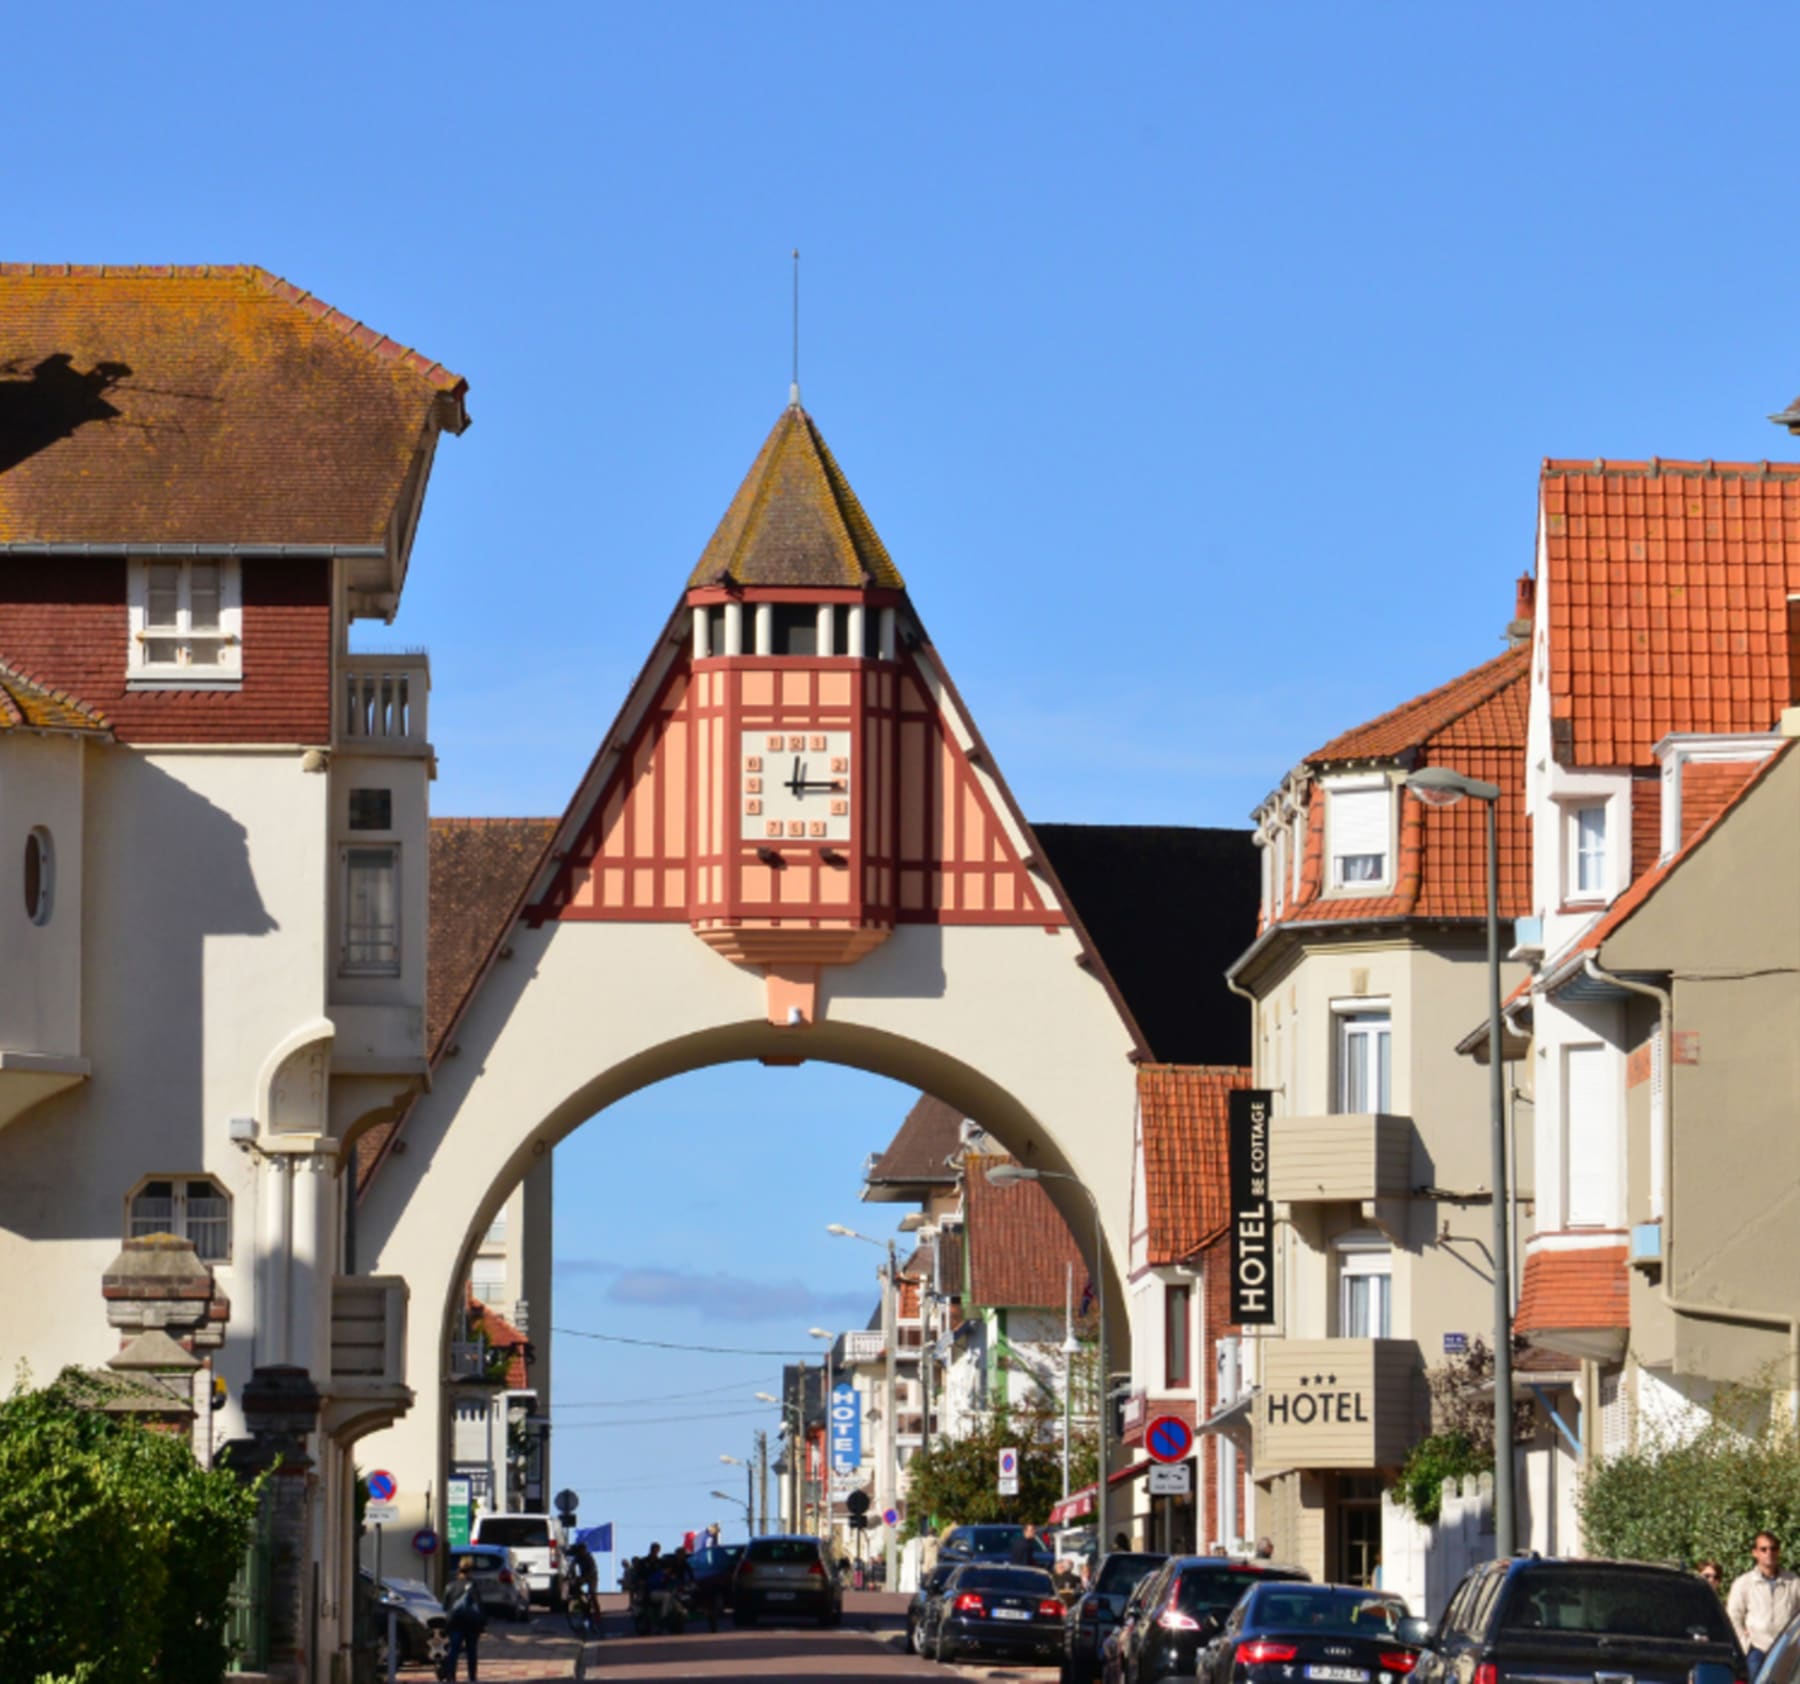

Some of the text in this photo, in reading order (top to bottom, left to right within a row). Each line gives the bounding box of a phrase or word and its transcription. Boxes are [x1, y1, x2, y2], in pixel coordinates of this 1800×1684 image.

[1239, 1102, 1266, 1311] HOTEL BE COTTAGE
[832, 1391, 855, 1467] HOTEL
[1268, 1392, 1368, 1424] HOTEL
